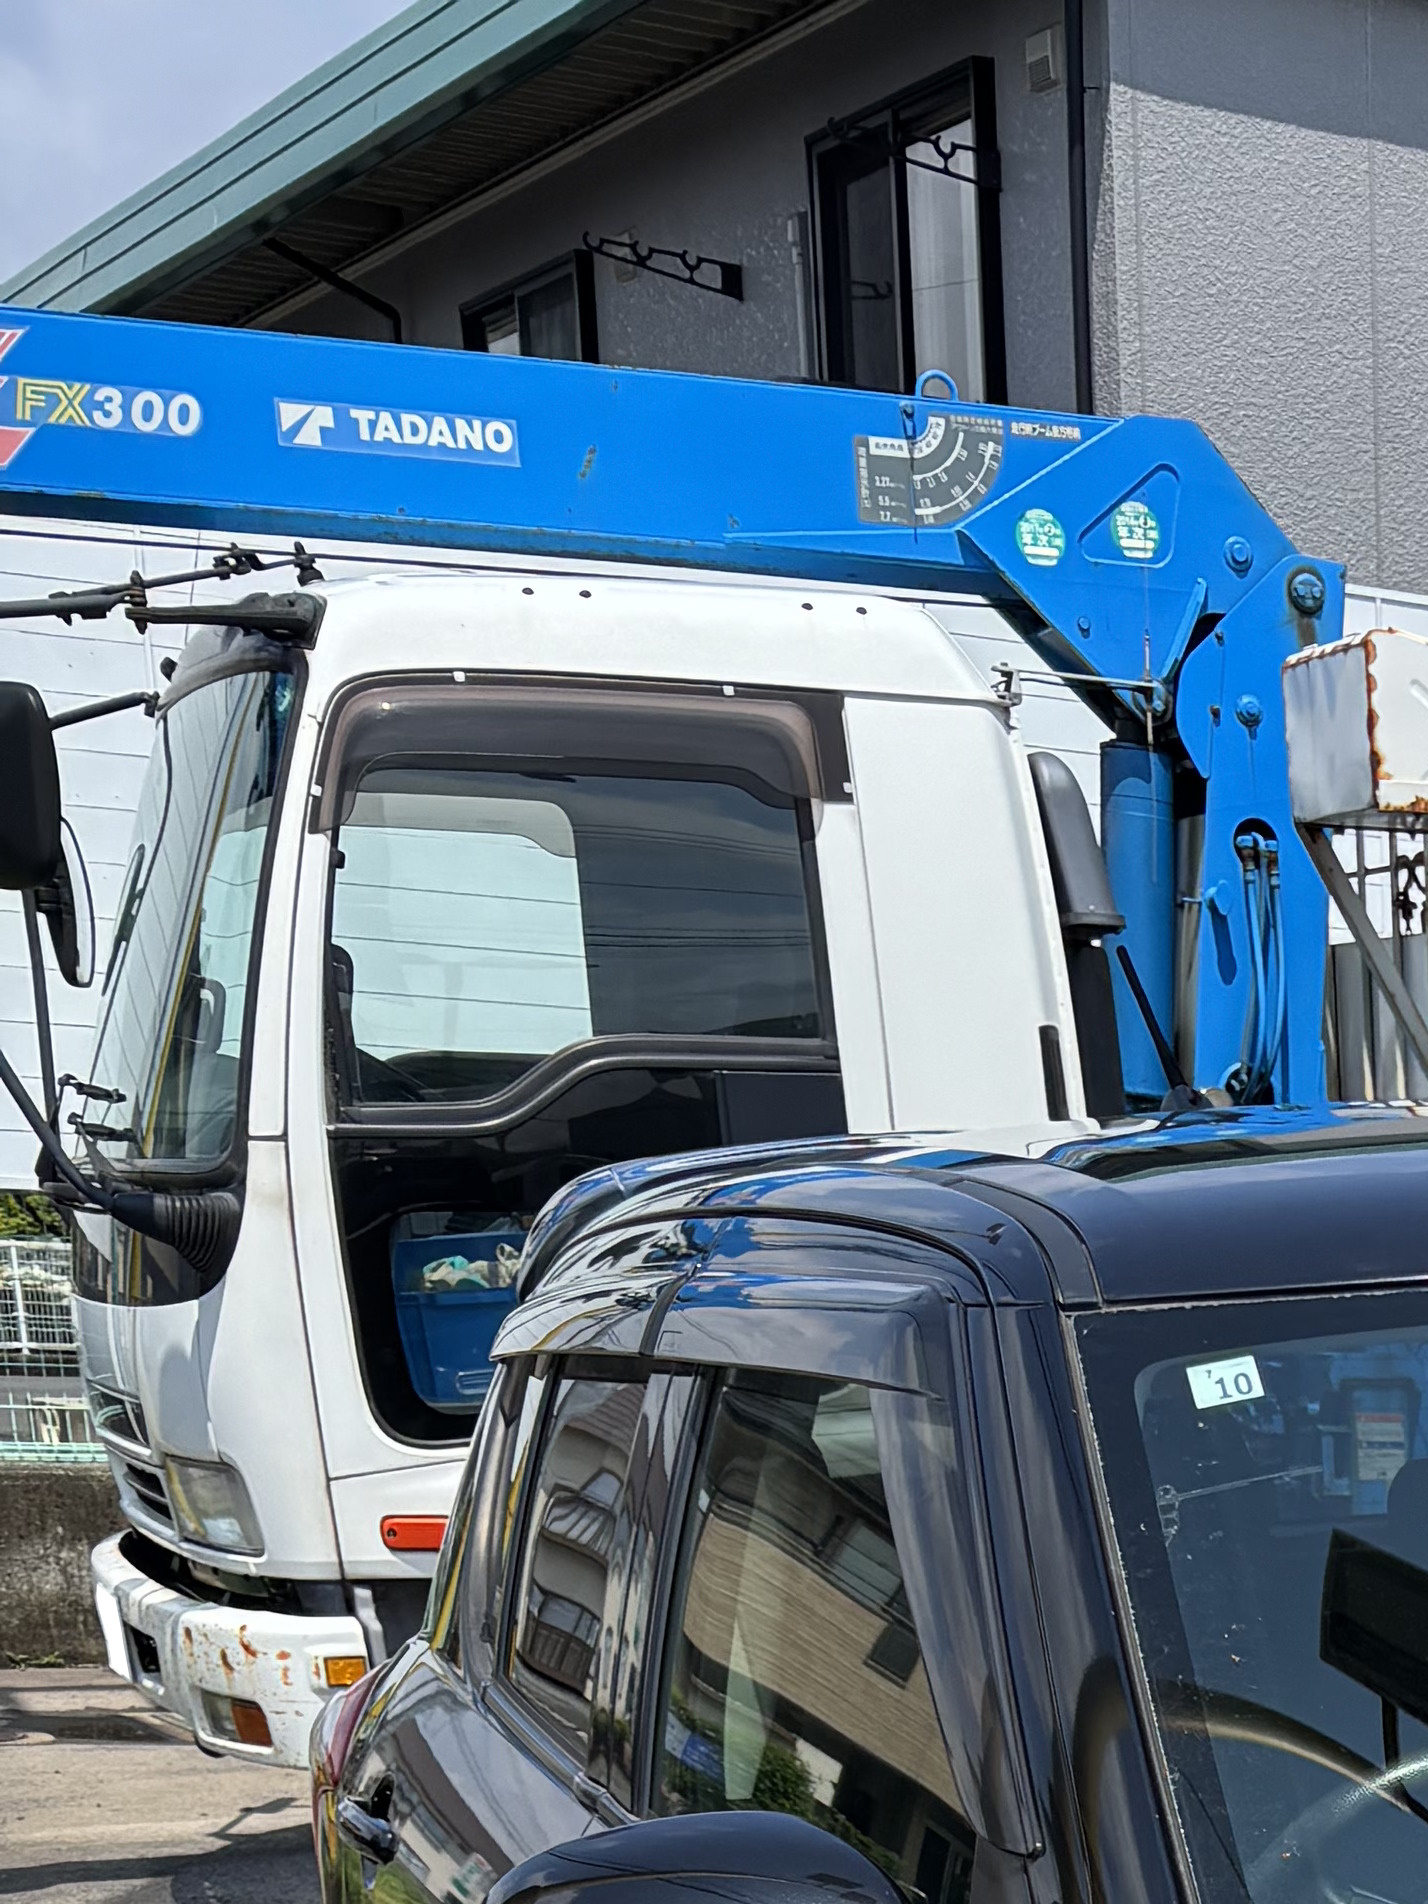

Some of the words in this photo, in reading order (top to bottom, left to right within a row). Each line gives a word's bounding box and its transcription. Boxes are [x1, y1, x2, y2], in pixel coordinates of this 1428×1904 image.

[16, 377, 201, 436] FX300
[350, 408, 514, 453] TADANO
[1215, 1372, 1254, 1400] 10
